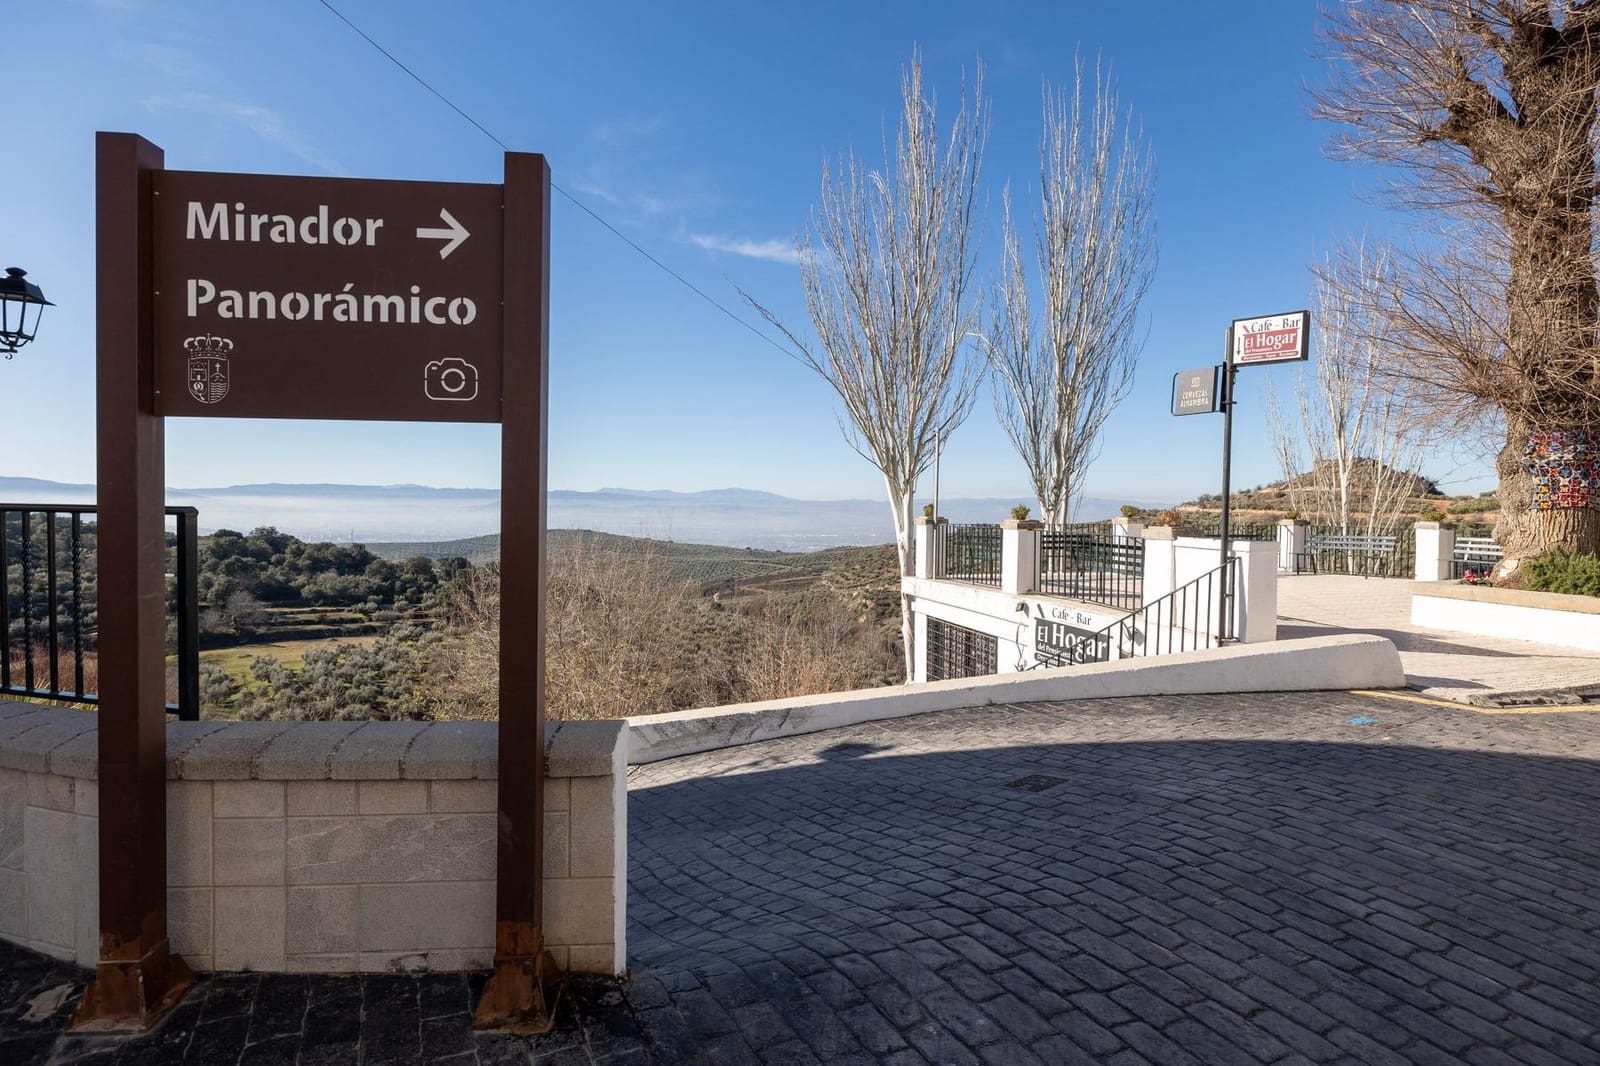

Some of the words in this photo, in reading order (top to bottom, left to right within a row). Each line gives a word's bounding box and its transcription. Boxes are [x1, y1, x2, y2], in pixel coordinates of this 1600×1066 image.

[186, 201, 384, 247] Mirador
[186, 278, 477, 326] Panorámico
[1282, 317, 1301, 329] Bar
[1245, 337, 1253, 348] El
[1256, 332, 1296, 350] Hogar
[1076, 612, 1092, 626] Bar
[1037, 625, 1048, 643] El
[1052, 623, 1107, 662] Hogar
